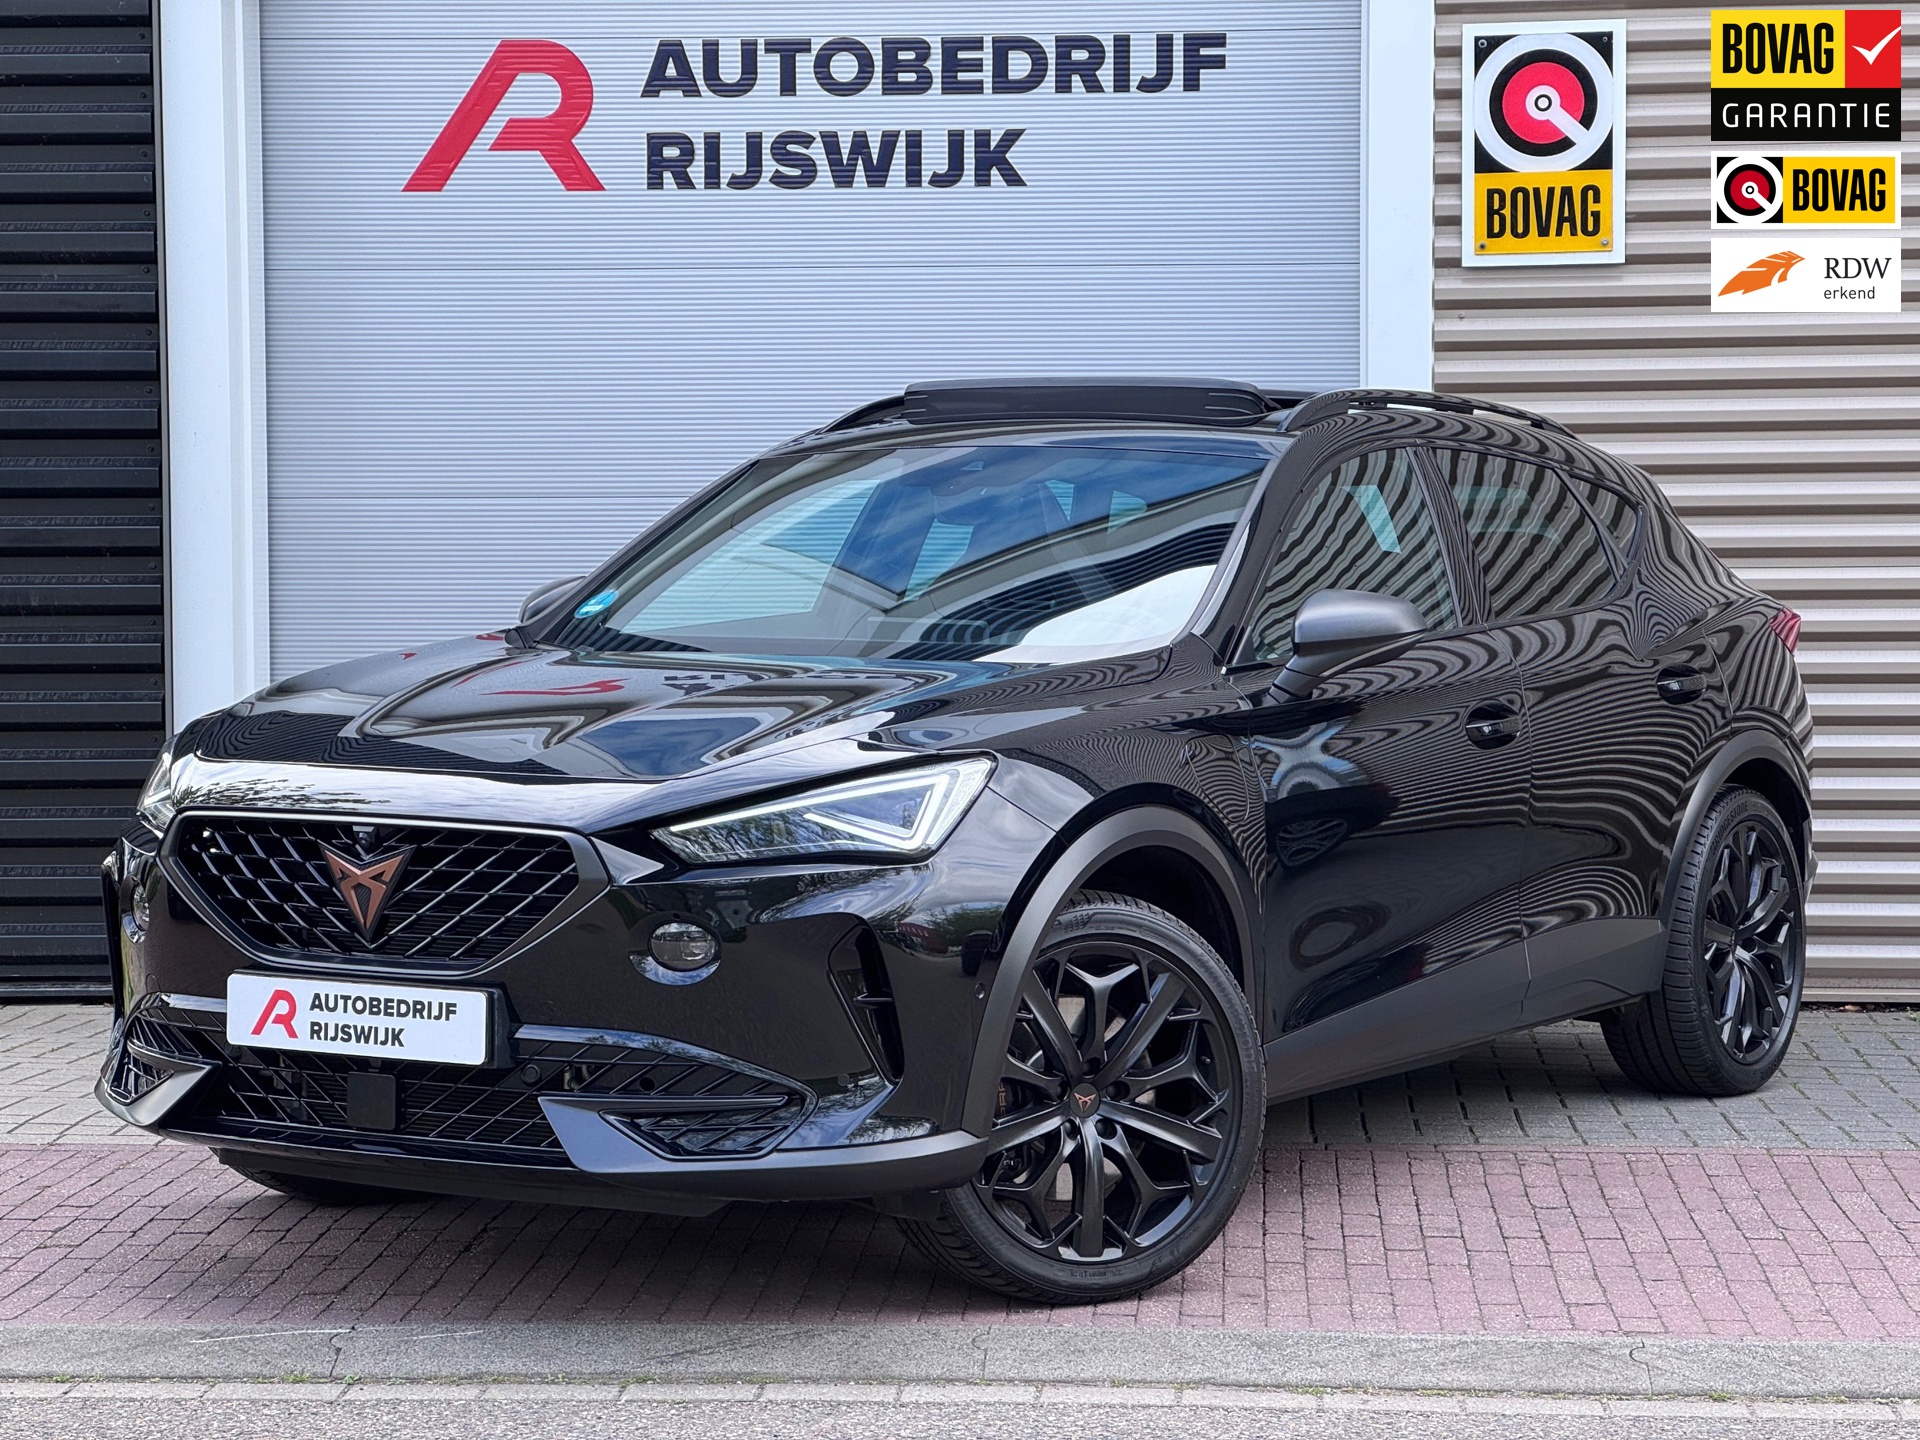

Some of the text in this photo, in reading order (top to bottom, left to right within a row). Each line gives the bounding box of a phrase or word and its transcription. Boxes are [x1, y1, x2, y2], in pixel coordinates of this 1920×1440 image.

[640, 33, 1227, 97] AUTOBEDRIJF
[646, 128, 1027, 191] RIJSWIJK
[1486, 184, 1601, 239] BOVAG
[309, 992, 457, 1022] AUTOBEDRIJF
[309, 1021, 405, 1047] RIJSWIJK
